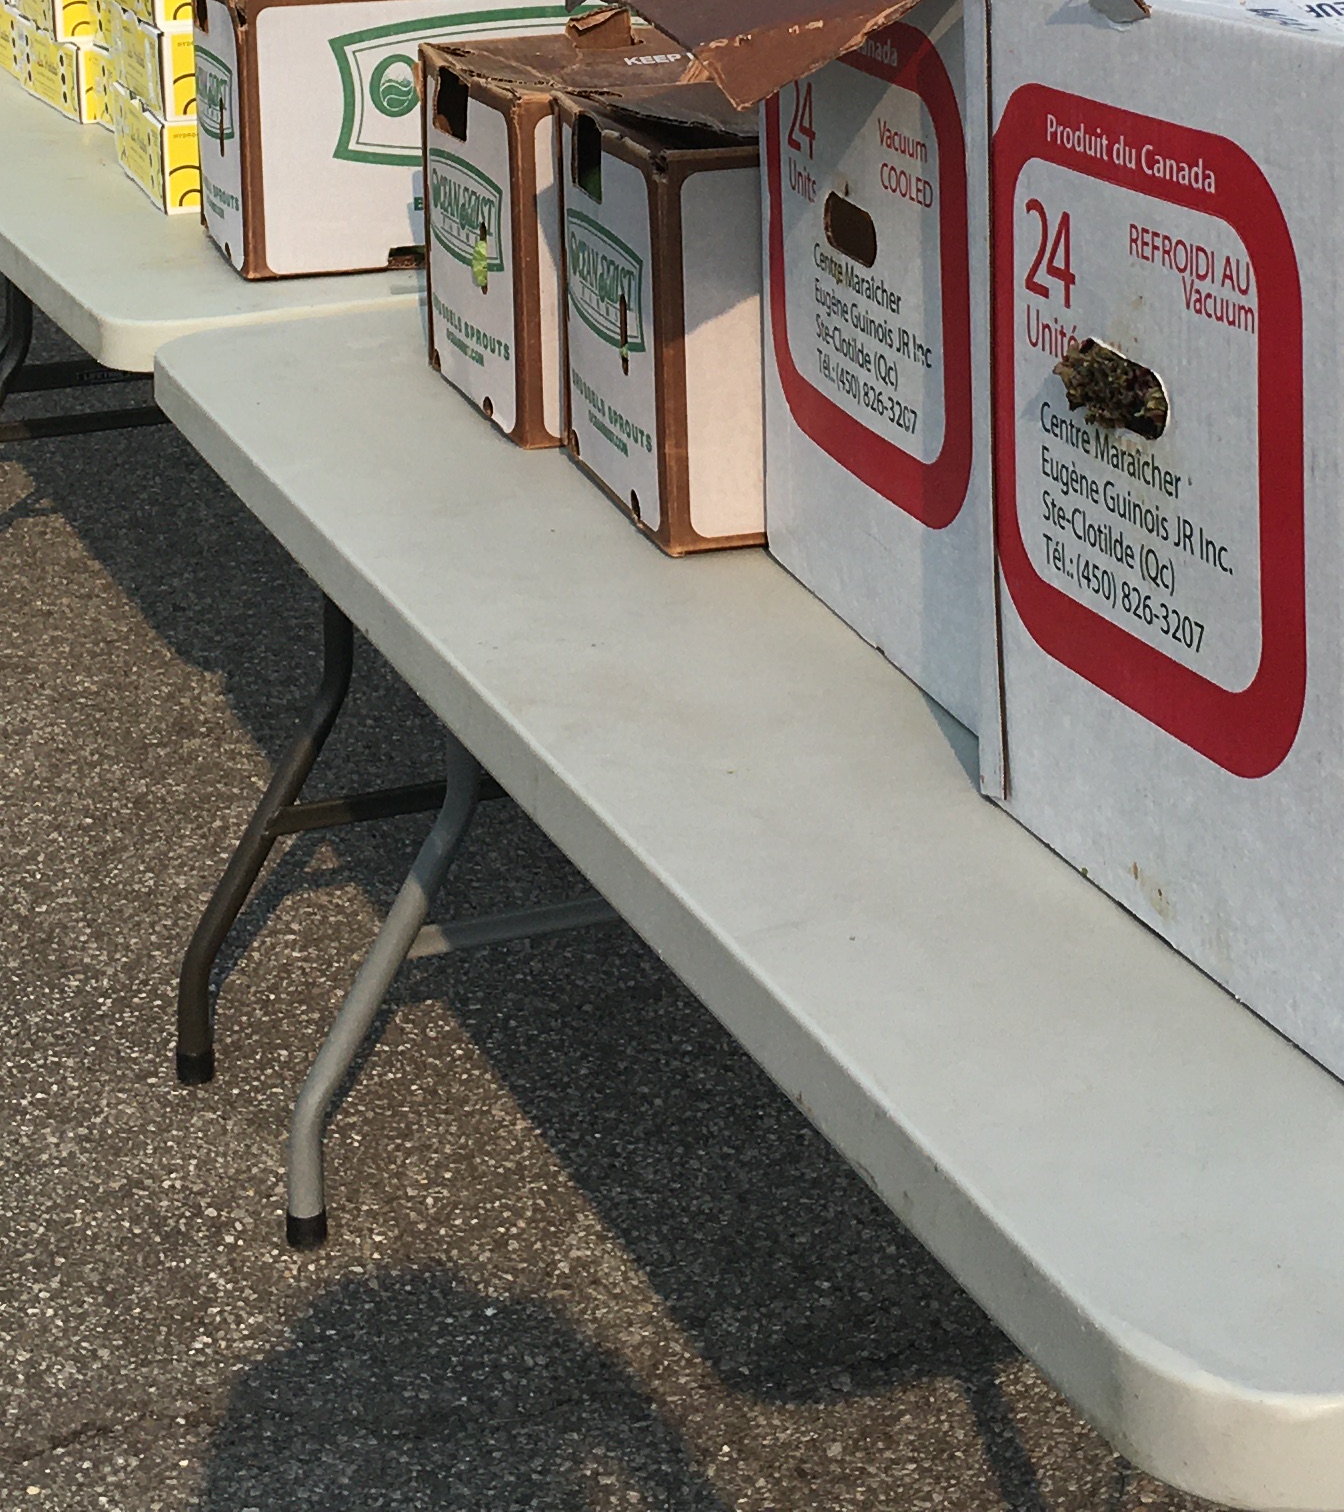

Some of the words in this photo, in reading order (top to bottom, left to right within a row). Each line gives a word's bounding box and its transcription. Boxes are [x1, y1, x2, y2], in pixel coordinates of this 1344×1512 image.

[625, 52, 680, 66] KEEP
[858, 39, 898, 67] anada
[787, 80, 816, 160] 24
[877, 118, 928, 164] Vacuum
[1046, 114, 1108, 161] Produit
[1112, 135, 1136, 170] du
[1141, 144, 1216, 194] Canada
[789, 157, 817, 203] Units
[880, 162, 934, 208] COOLED
[814, 243, 844, 287] Centre
[845, 261, 902, 316] Maraîcher
[1025, 198, 1076, 309] 24
[1129, 223, 1216, 285] REFROIDI
[1221, 256, 1251, 296] AU
[464, 321, 510, 361] SPROUTS
[815, 280, 849, 328] Eugène
[850, 309, 892, 349] Guinois
[896, 328, 910, 359] JR
[1182, 275, 1255, 335] Vacuum
[816, 314, 872, 372] Ste-Clotilde
[874, 351, 898, 392] (Qc)
[608, 405, 652, 453] SPROUTS
[863, 379, 918, 436] 826-3207
[1040, 401, 1091, 455] Centre
[1094, 434, 1182, 499] Maraîcher
[1041, 445, 1099, 505] Eugène
[1104, 482, 1169, 542] Guinois
[1174, 516, 1194, 552] JR
[1200, 527, 1234, 575] Inc.
[1043, 491, 1135, 569] Ste-Clotilde
[1140, 543, 1175, 597] (Qc)
[1121, 582, 1205, 654] 826-3207
